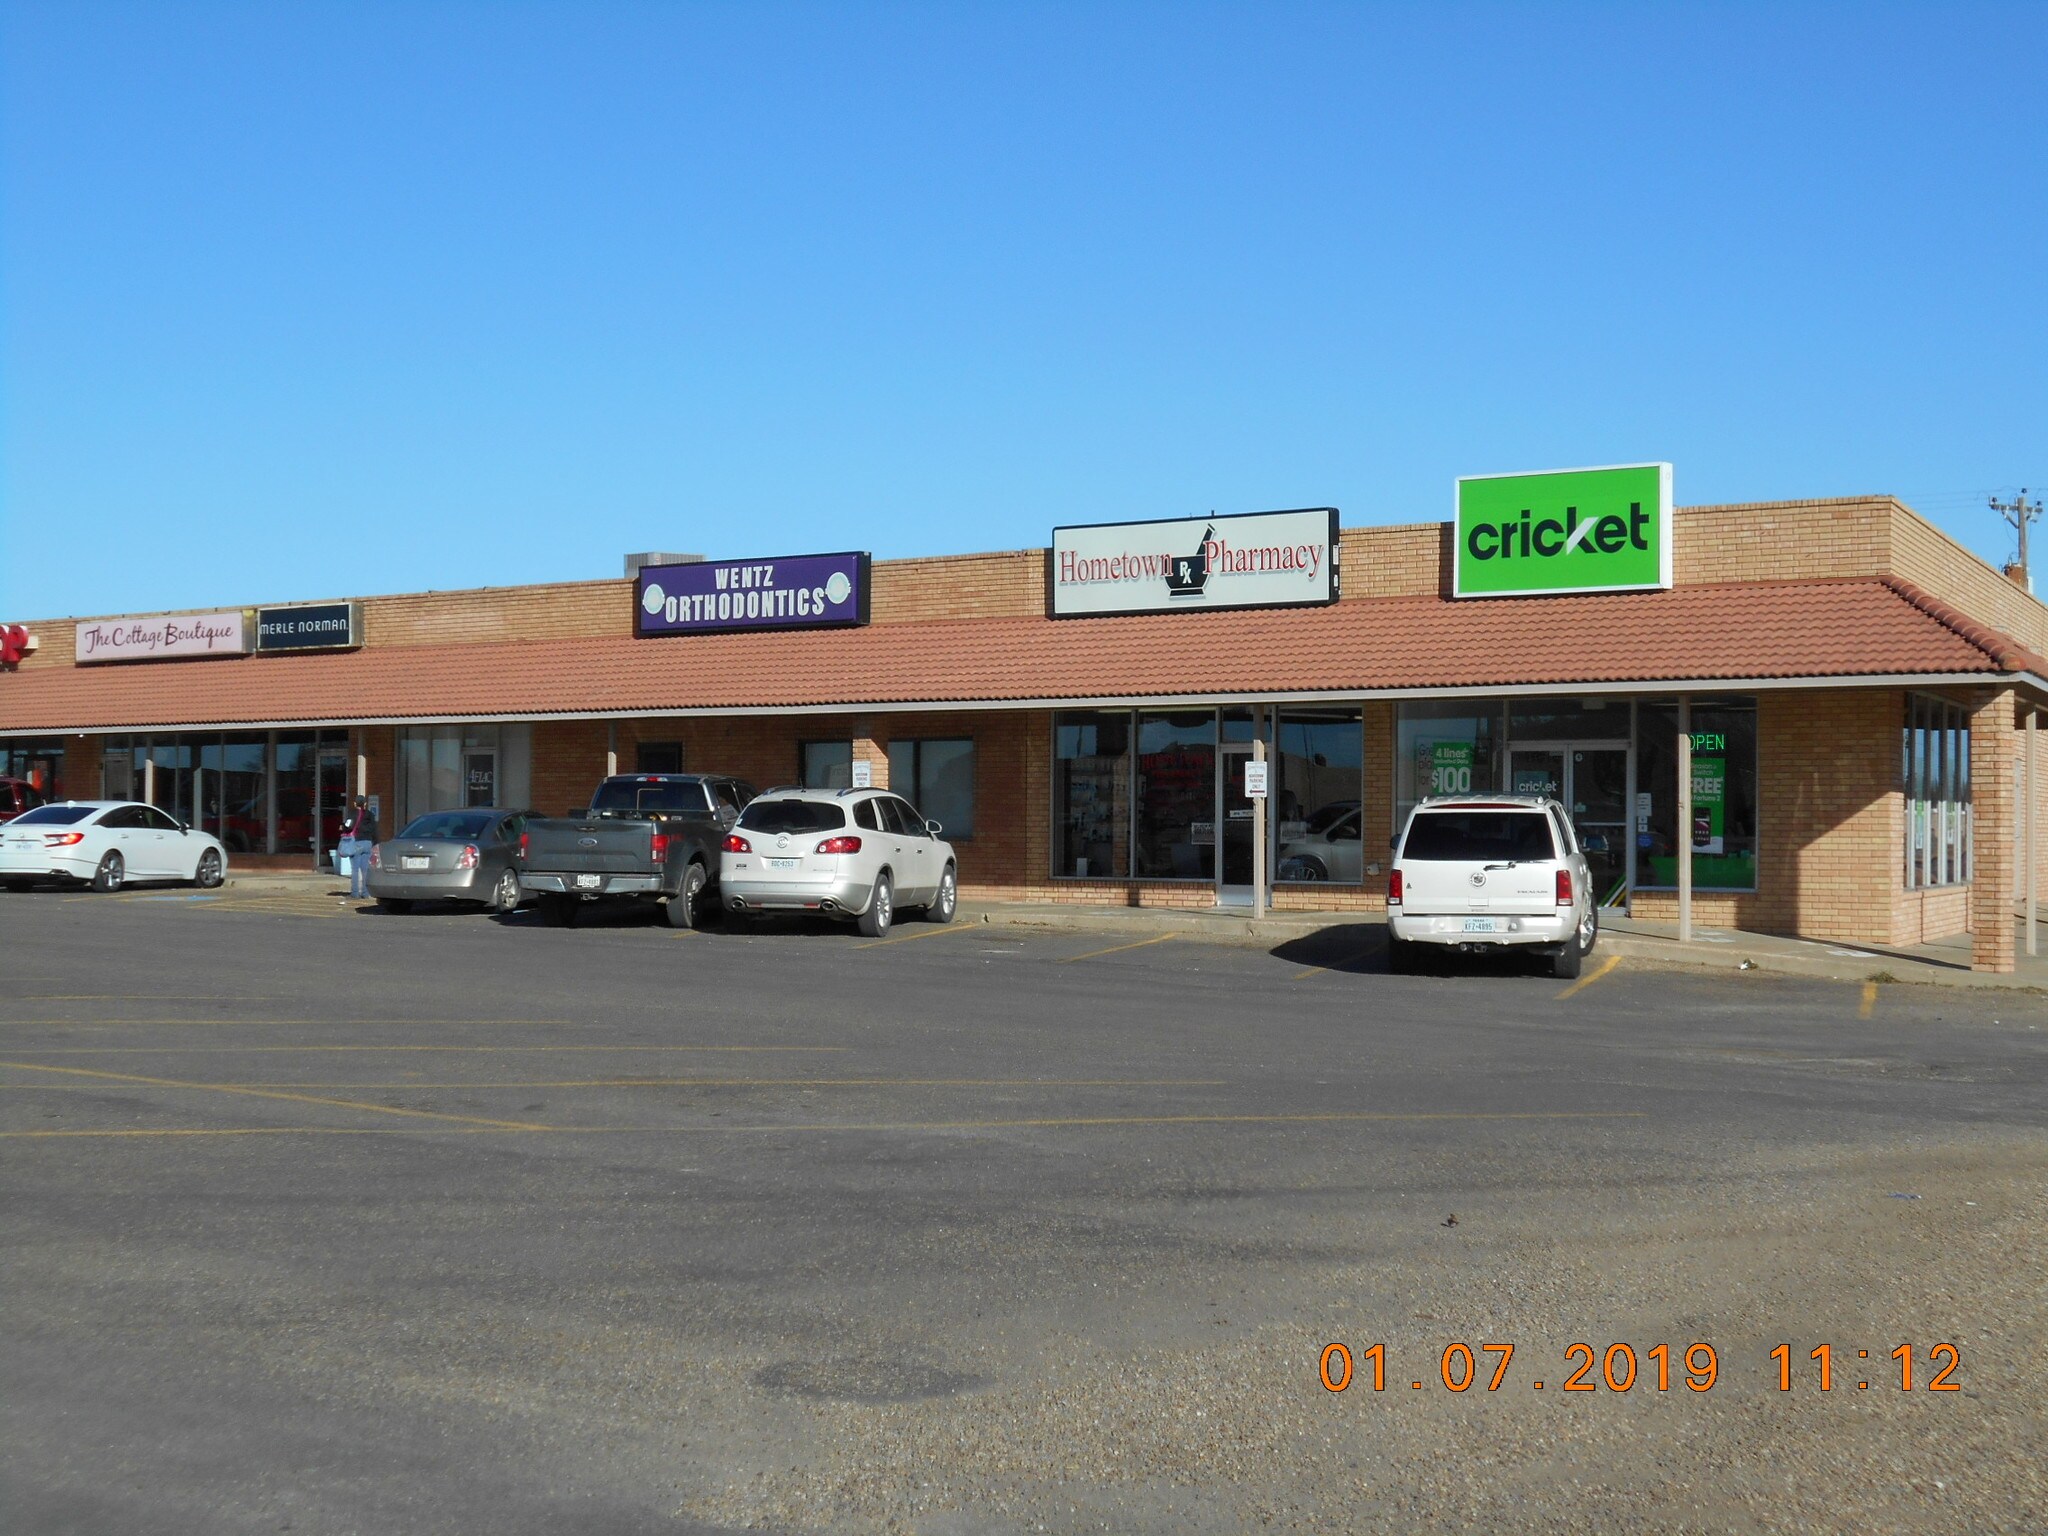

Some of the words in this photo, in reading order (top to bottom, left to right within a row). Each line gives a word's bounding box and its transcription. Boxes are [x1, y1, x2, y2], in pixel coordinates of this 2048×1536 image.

[1468, 502, 1650, 561] cricket
[715, 565, 774, 590] WENTZ
[1059, 550, 1174, 583] Hometown
[1203, 539, 1324, 579] Pharmacy
[665, 587, 825, 623] ORTHODONTICS
[85, 628, 111, 654] The
[112, 625, 164, 650] Cottage
[164, 621, 234, 649] Boutique
[259, 622, 294, 635] MERLE
[298, 618, 347, 633] NORMAN
[1431, 766, 1471, 793] $100
